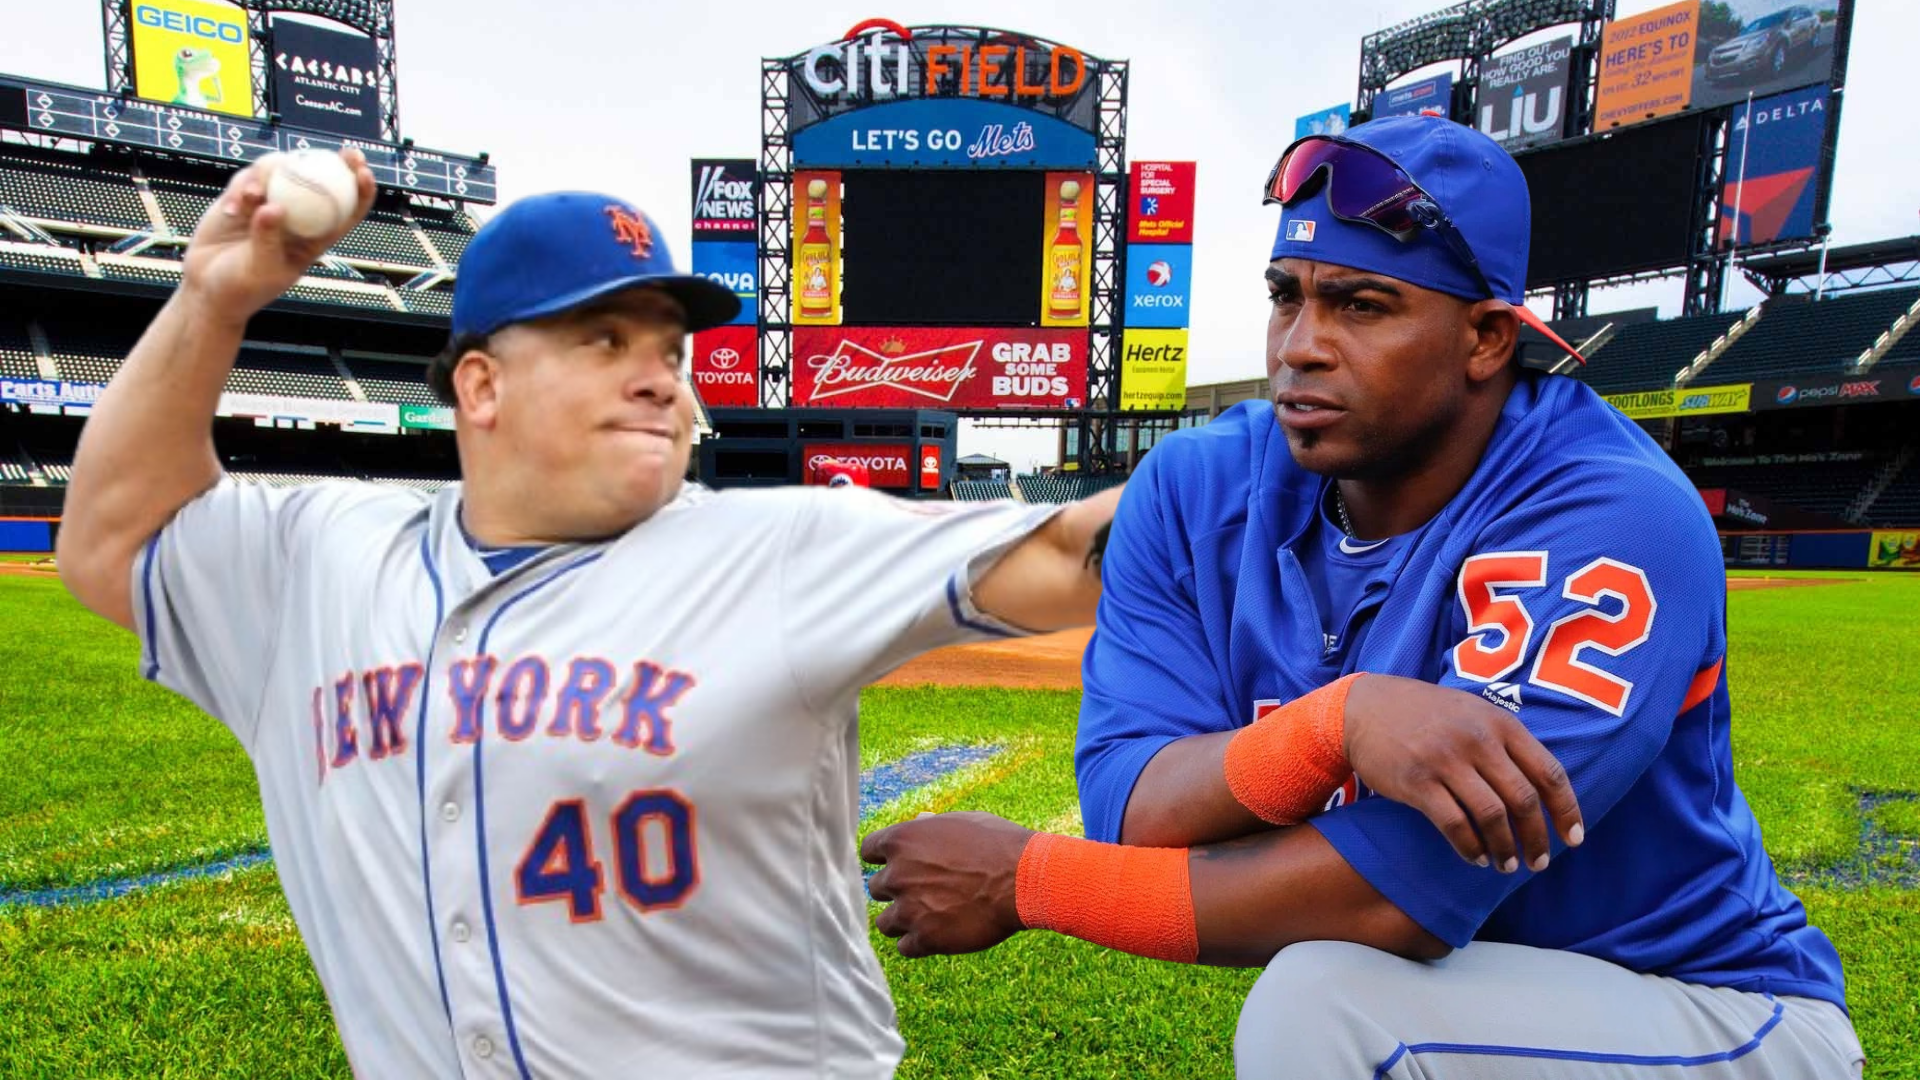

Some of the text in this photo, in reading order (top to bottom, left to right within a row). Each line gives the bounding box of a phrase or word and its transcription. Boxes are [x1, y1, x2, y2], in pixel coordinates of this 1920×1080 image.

[136, 5, 243, 43] GEICO
[1639, 11, 1691, 35] EQUINOX
[1500, 44, 1551, 67] FIND OUT
[1606, 31, 1690, 68] HERE'S TO
[275, 53, 377, 88] CAESARS
[804, 32, 1087, 96] citi FIELD
[1481, 47, 1571, 82] HOW GOOD YOU
[294, 76, 361, 95] ATLANTIC CITY
[1489, 62, 1558, 89] REALLY ARE.
[296, 94, 362, 116] CaesarsAC.com
[1480, 85, 1561, 141] LIU
[1756, 98, 1823, 125] DELTA
[852, 121, 1034, 158] LET'S GO Mets
[713, 181, 754, 200] FOX
[1140, 179, 1171, 187] SPECIAL
[1140, 187, 1176, 195] SURGERY
[702, 201, 755, 219] NEWS
[694, 222, 756, 231] channel
[695, 272, 755, 291] OYA
[1133, 293, 1184, 308] xerox
[992, 343, 1071, 362] GRAB
[1126, 343, 1184, 362] Hertz
[695, 371, 754, 385] TOYOTA
[807, 354, 977, 385] Budweiser
[1005, 363, 1057, 376] SOME
[992, 376, 1069, 396] BUDS
[1123, 391, 1183, 402] hertzequip.com
[1799, 380, 1882, 400] pepsi MAX
[1679, 388, 1741, 410] SUBWAY
[1453, 550, 1658, 718] 52
[448, 655, 696, 757] YORK
[1482, 688, 1521, 713] Majestic
[513, 788, 701, 925] 40
